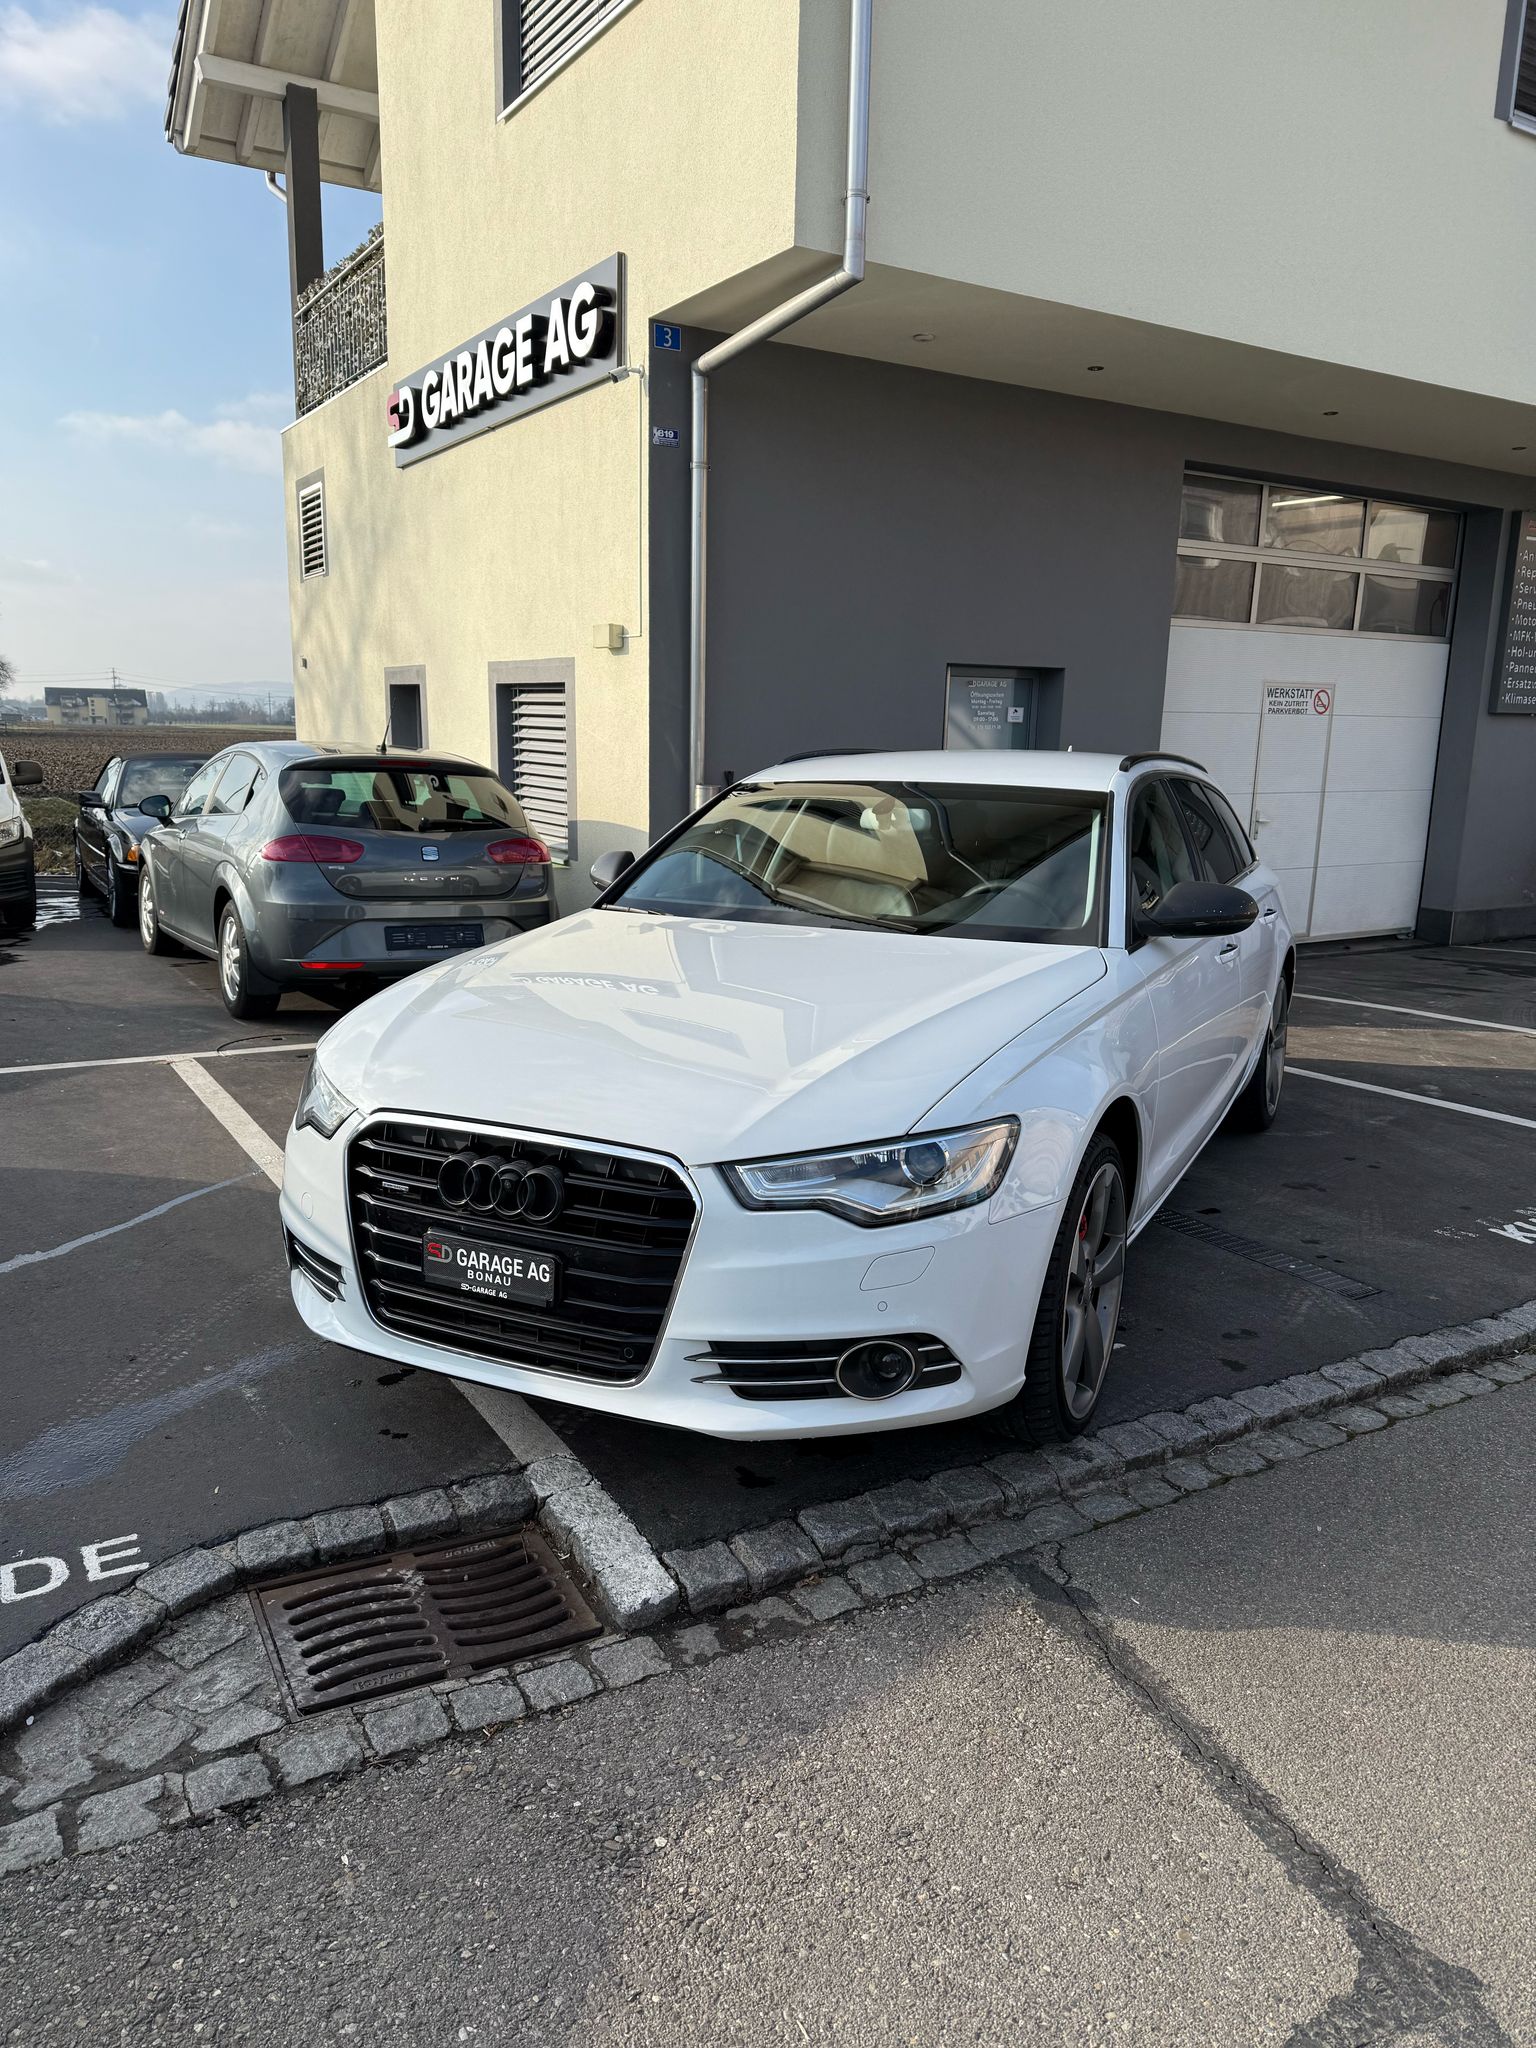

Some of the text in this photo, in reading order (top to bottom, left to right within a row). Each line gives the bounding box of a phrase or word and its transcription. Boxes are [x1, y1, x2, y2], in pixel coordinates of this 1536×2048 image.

[663, 327, 672, 347] 3
[421, 313, 533, 429] GARAGE
[543, 281, 598, 373] AG
[1522, 549, 1536, 561] An
[1513, 630, 1536, 642] MFK-
[1509, 661, 1536, 673] Panne
[1267, 687, 1314, 699] WERKSTATT
[1267, 707, 1309, 715] PARKVERBOT
[427, 1242, 551, 1283] SD GARAGE AG
[467, 1269, 512, 1286] BONAU
[498, 1291, 508, 1299] AG
[0, 1533, 150, 1604] DE
